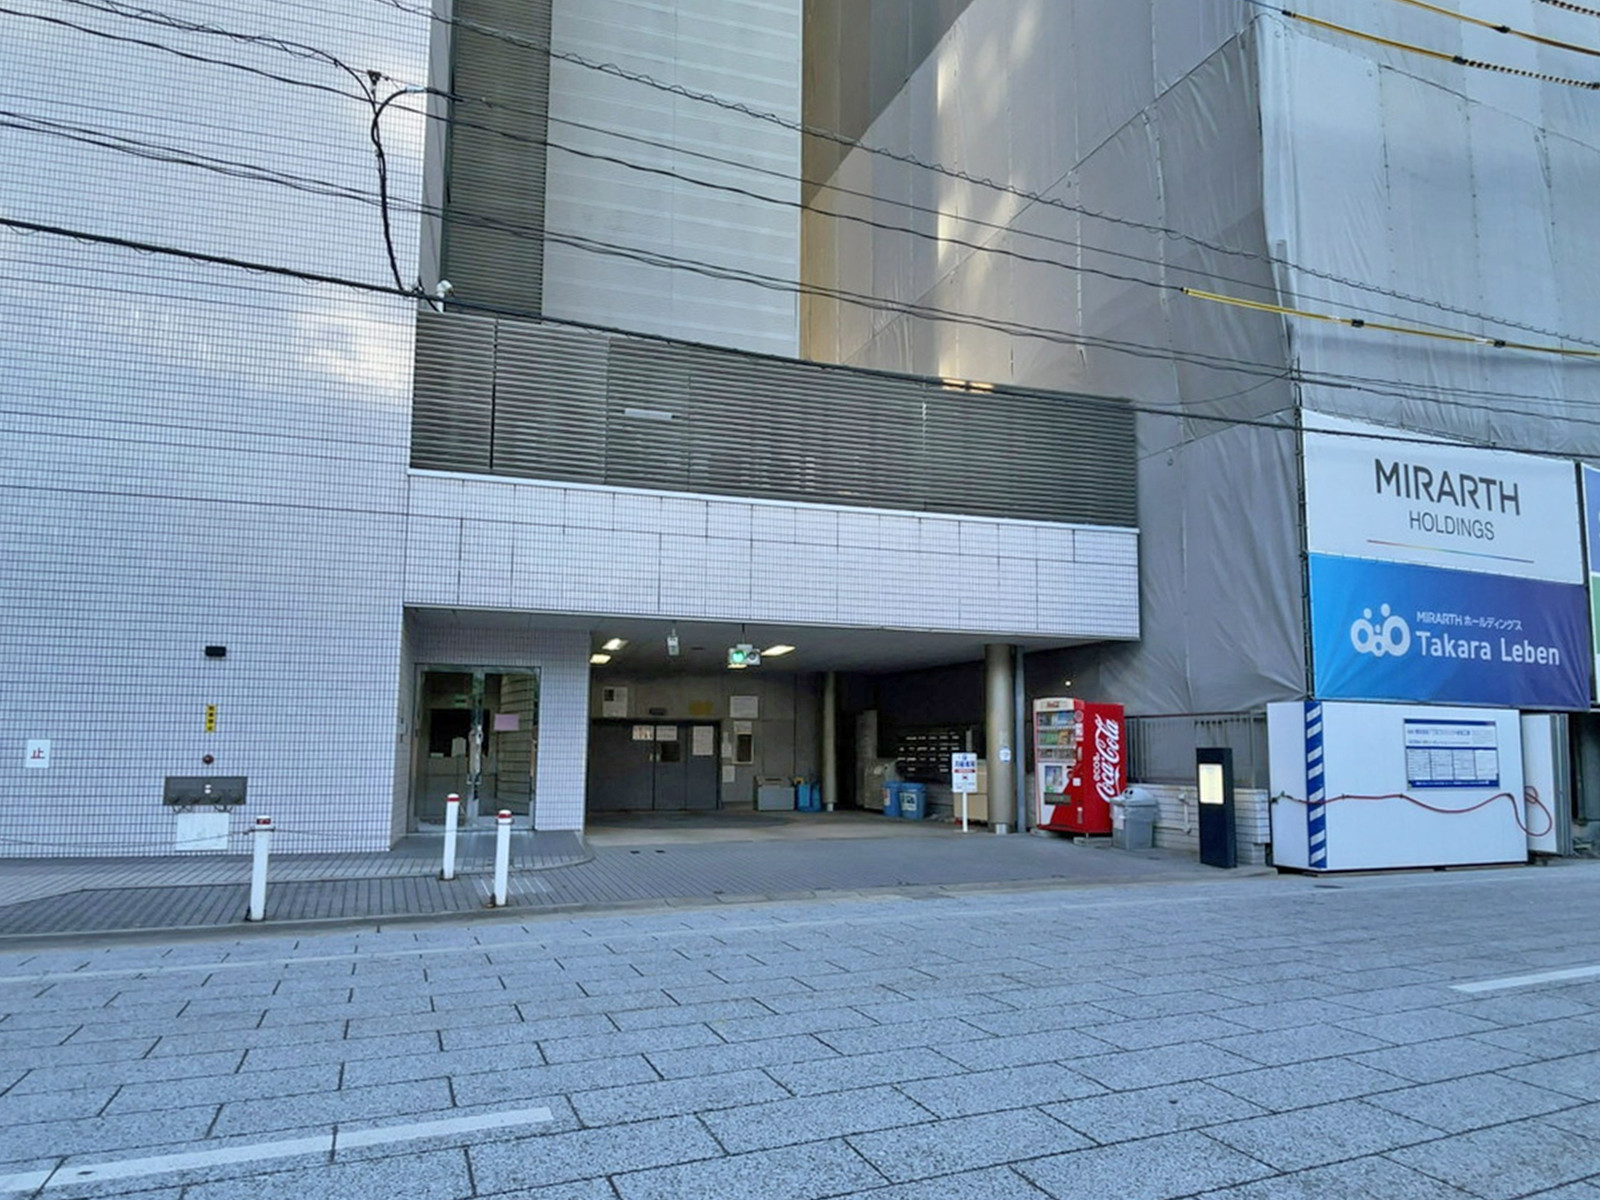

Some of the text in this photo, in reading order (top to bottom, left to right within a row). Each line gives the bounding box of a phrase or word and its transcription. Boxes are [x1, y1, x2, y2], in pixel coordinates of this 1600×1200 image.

[1375, 458, 1520, 516] MIRARTH
[1409, 510, 1495, 541] HOLDINGS
[1416, 611, 1523, 631] MIRARTH ホールディングス
[1415, 631, 1560, 666] Takara Leben
[30, 746, 45, 759] 止
[1095, 713, 1119, 803] Coca-Cola
